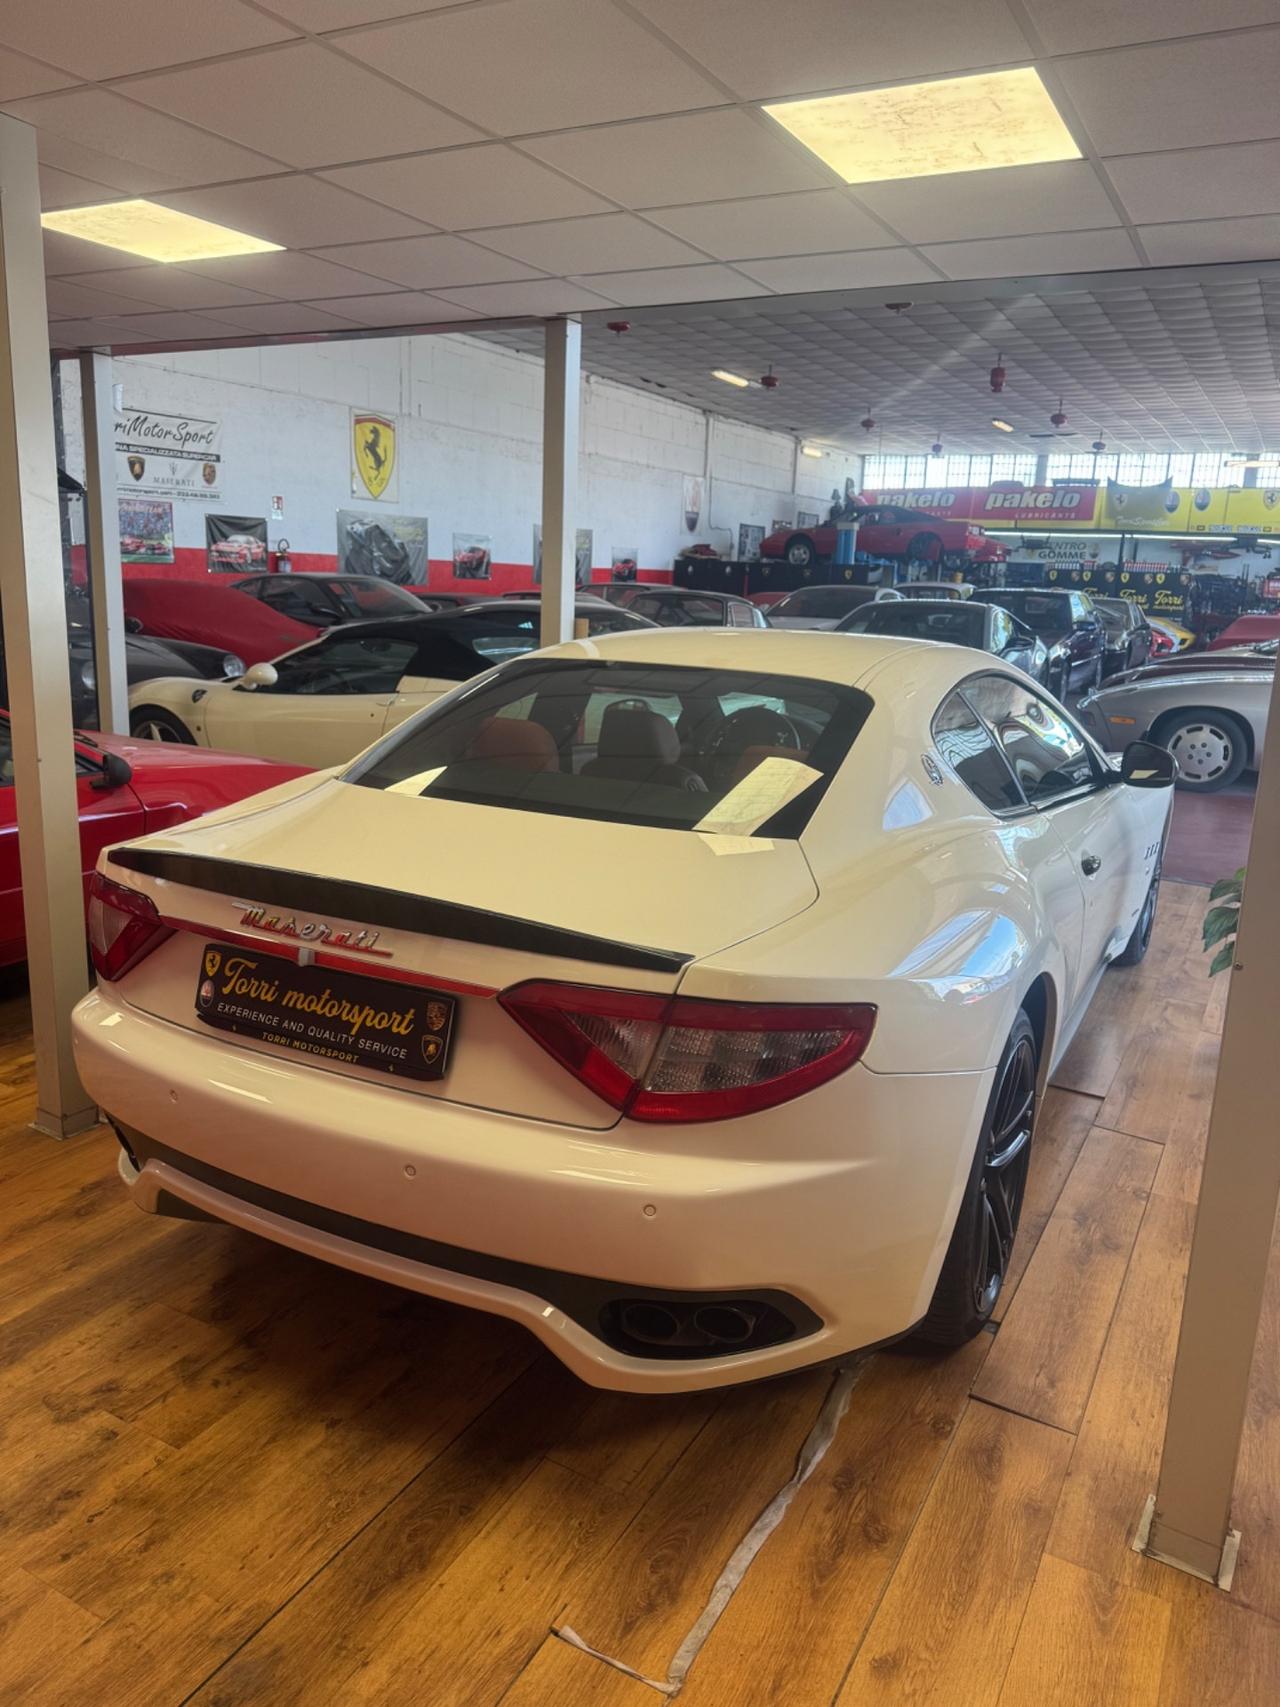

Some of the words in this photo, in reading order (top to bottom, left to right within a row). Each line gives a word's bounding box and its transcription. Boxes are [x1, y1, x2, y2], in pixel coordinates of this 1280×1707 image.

[153, 477, 195, 487] MASERATI
[876, 491, 956, 509] pakelo
[985, 490, 1081, 510] pakelo
[1038, 550, 1087, 560] GOMME
[1119, 588, 1148, 603] Torri
[1155, 590, 1184, 605] Torri
[232, 902, 393, 957] Maserati
[222, 957, 280, 1002] Torri
[281, 988, 416, 1036] motorsport
[217, 1002, 280, 1026] EXPERIENCE
[282, 1020, 304, 1033] AND
[307, 1026, 355, 1045] QUALITY
[358, 1038, 408, 1060] SERVICE
[262, 1031, 290, 1045] TORRI
[292, 1040, 360, 1064] MOTORSPORT
